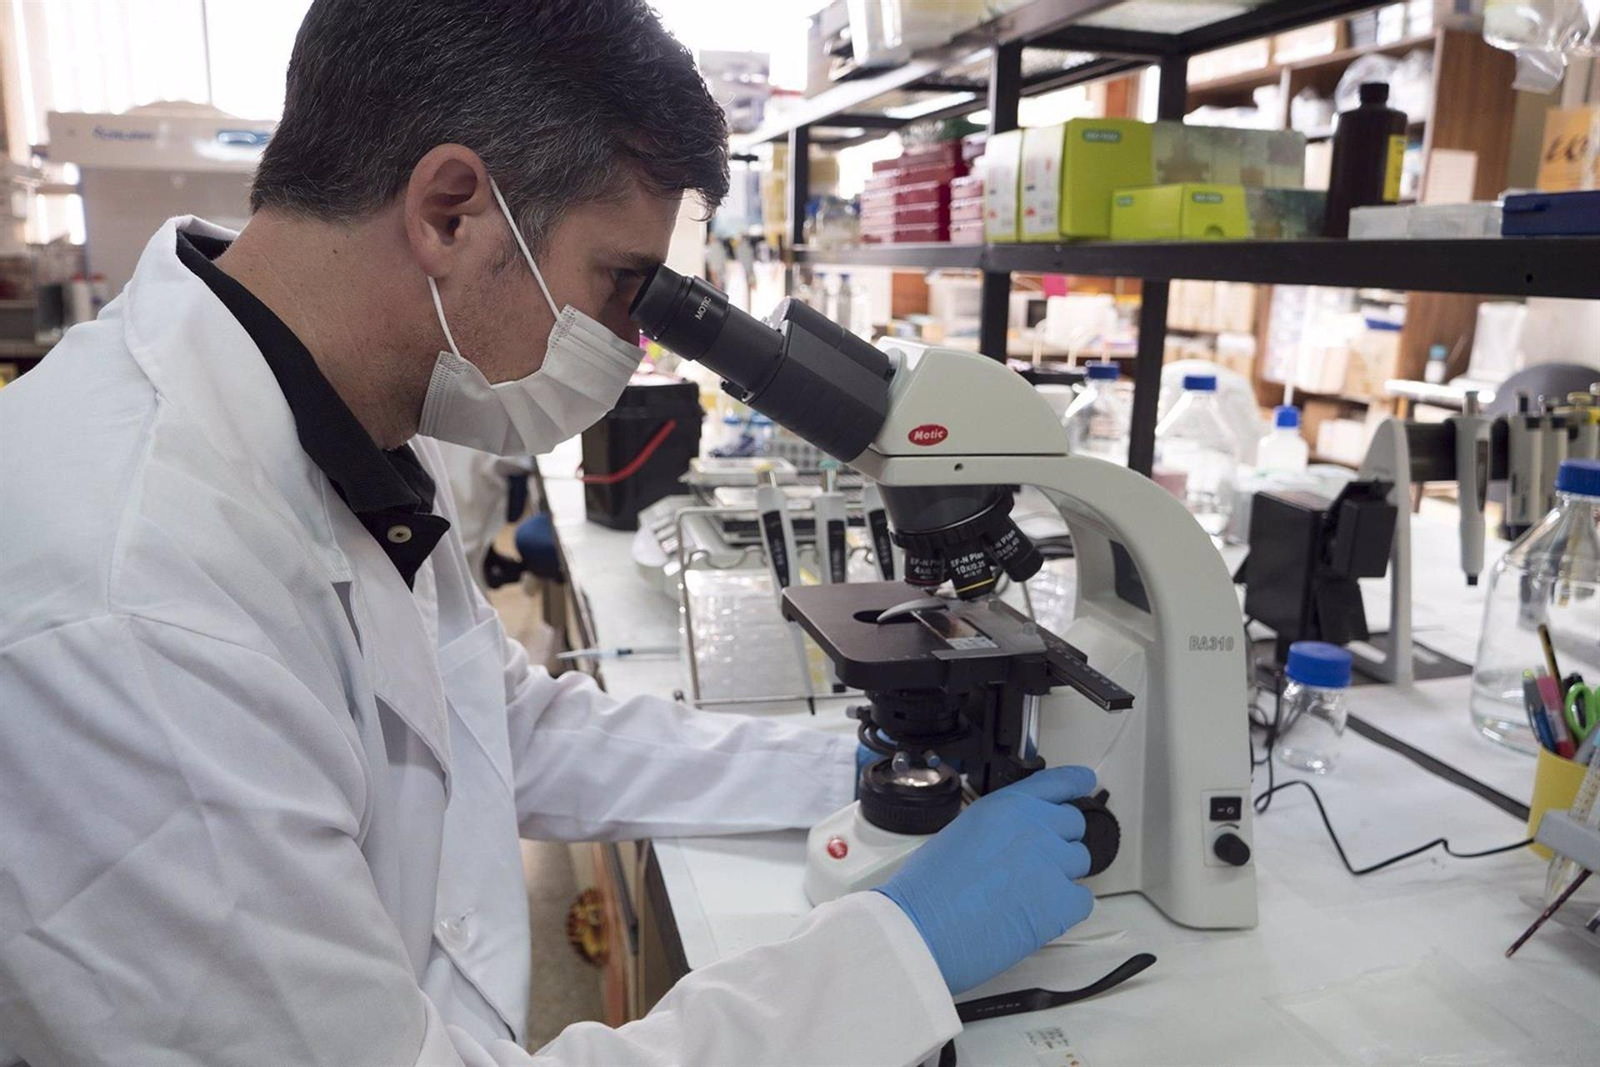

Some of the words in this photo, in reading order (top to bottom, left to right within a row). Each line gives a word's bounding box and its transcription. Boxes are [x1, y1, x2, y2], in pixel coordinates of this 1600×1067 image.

[695, 296, 711, 320] MOTIC
[913, 429, 945, 441] Motic
[1189, 635, 1234, 651] BA310
